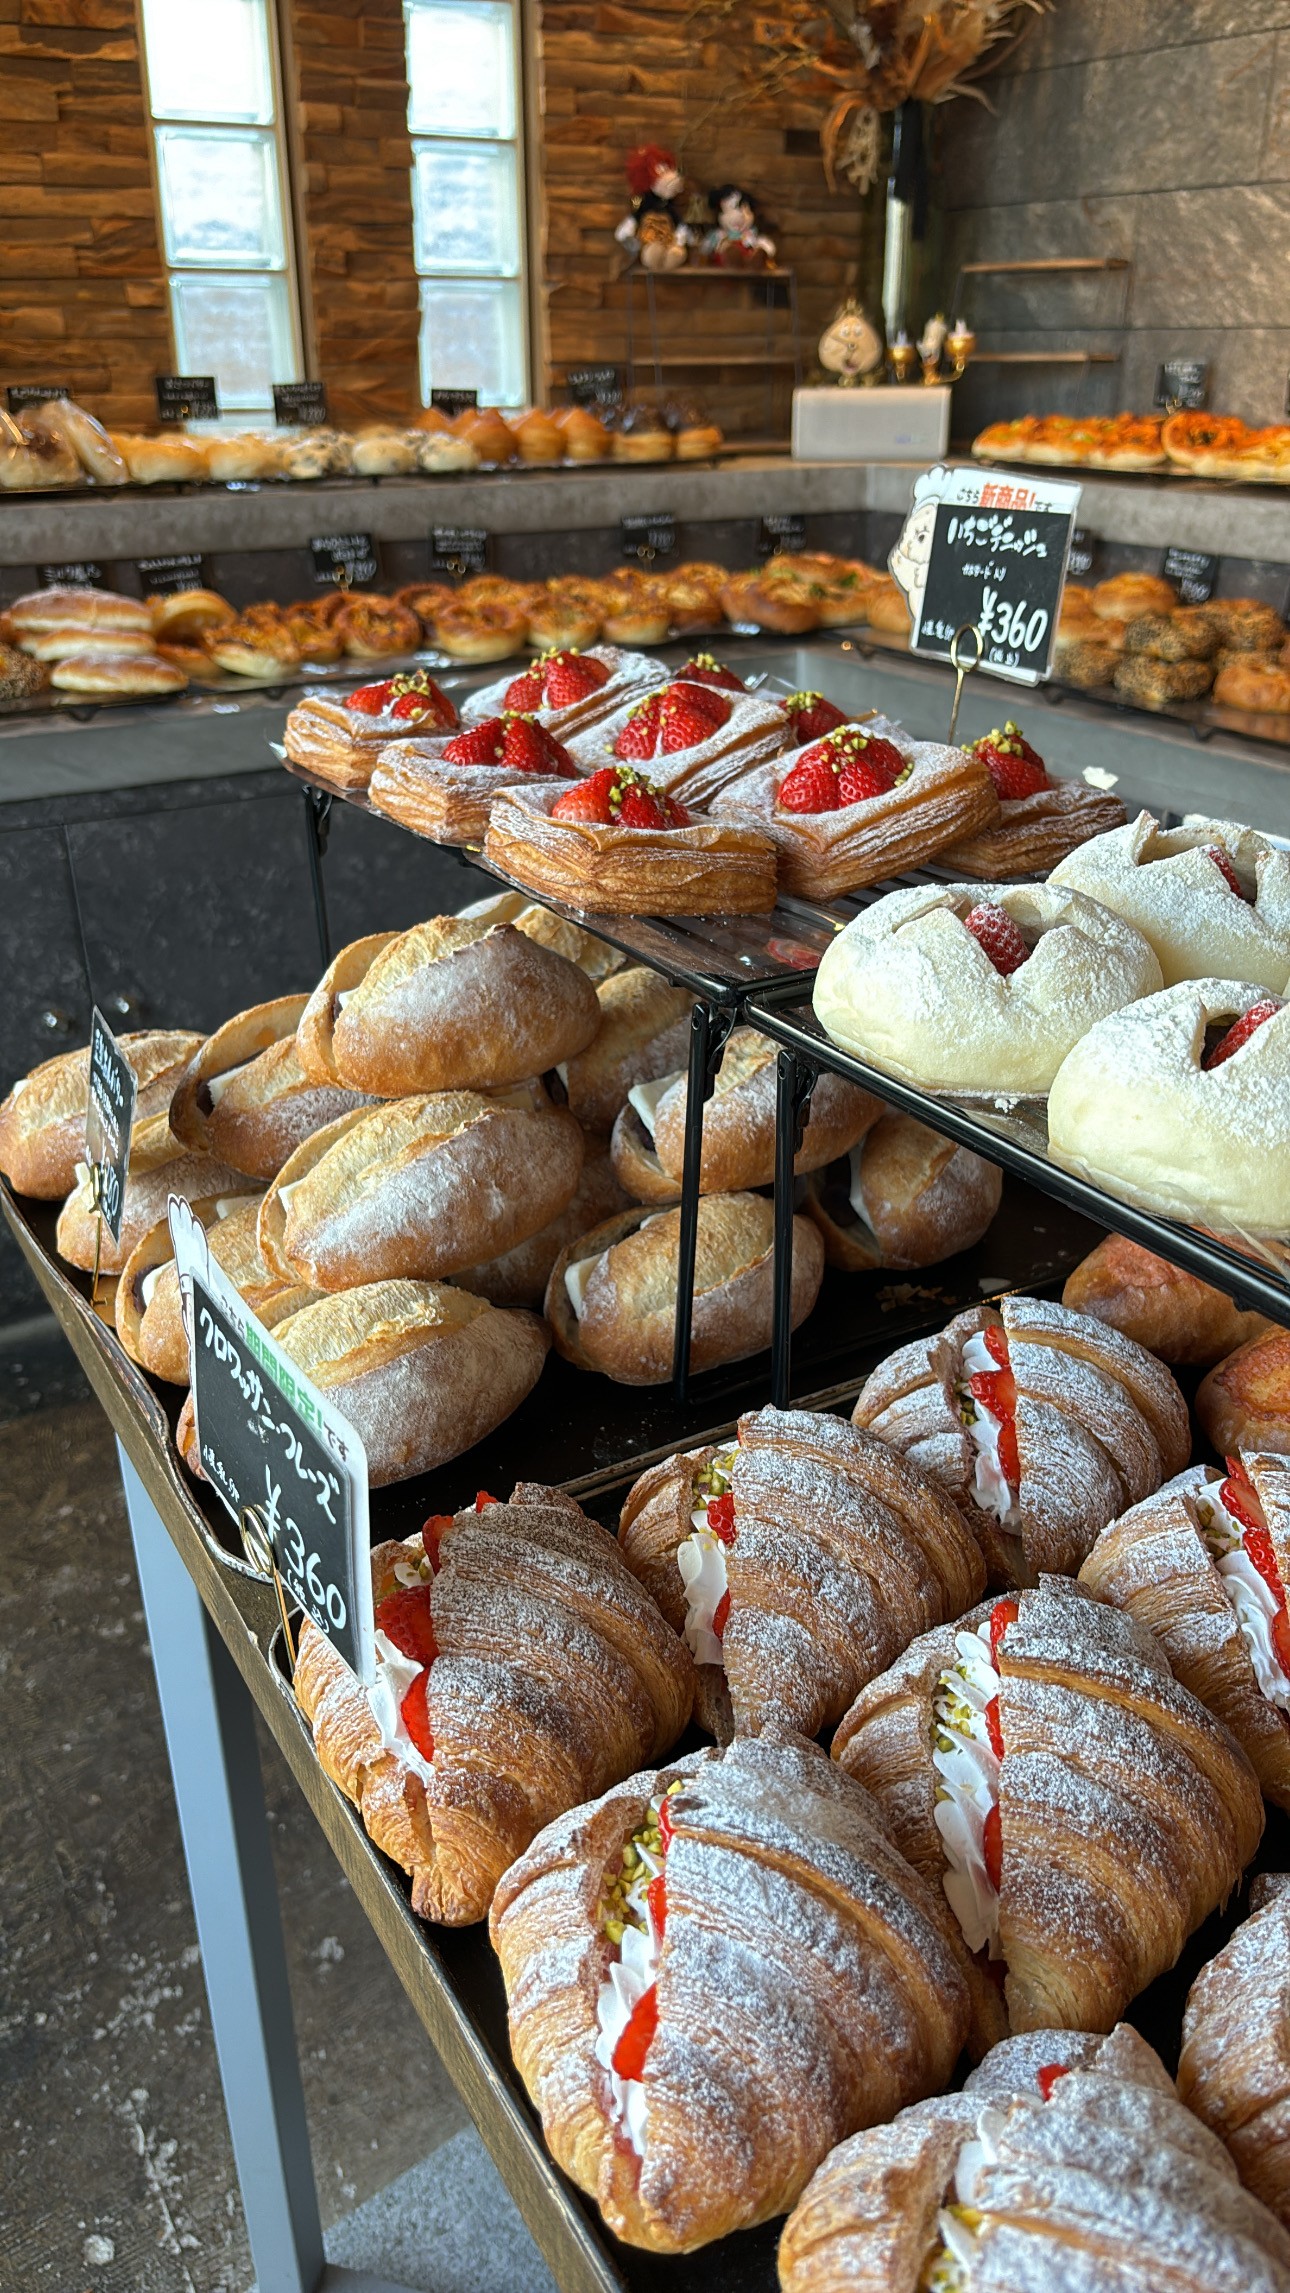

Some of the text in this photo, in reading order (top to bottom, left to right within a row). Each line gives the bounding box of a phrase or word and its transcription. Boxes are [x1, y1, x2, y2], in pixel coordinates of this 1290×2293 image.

[947, 513, 1048, 558] いちごデニッシュ
[977, 586, 1049, 652] ¥360
[265, 1464, 347, 1629] ¥360
